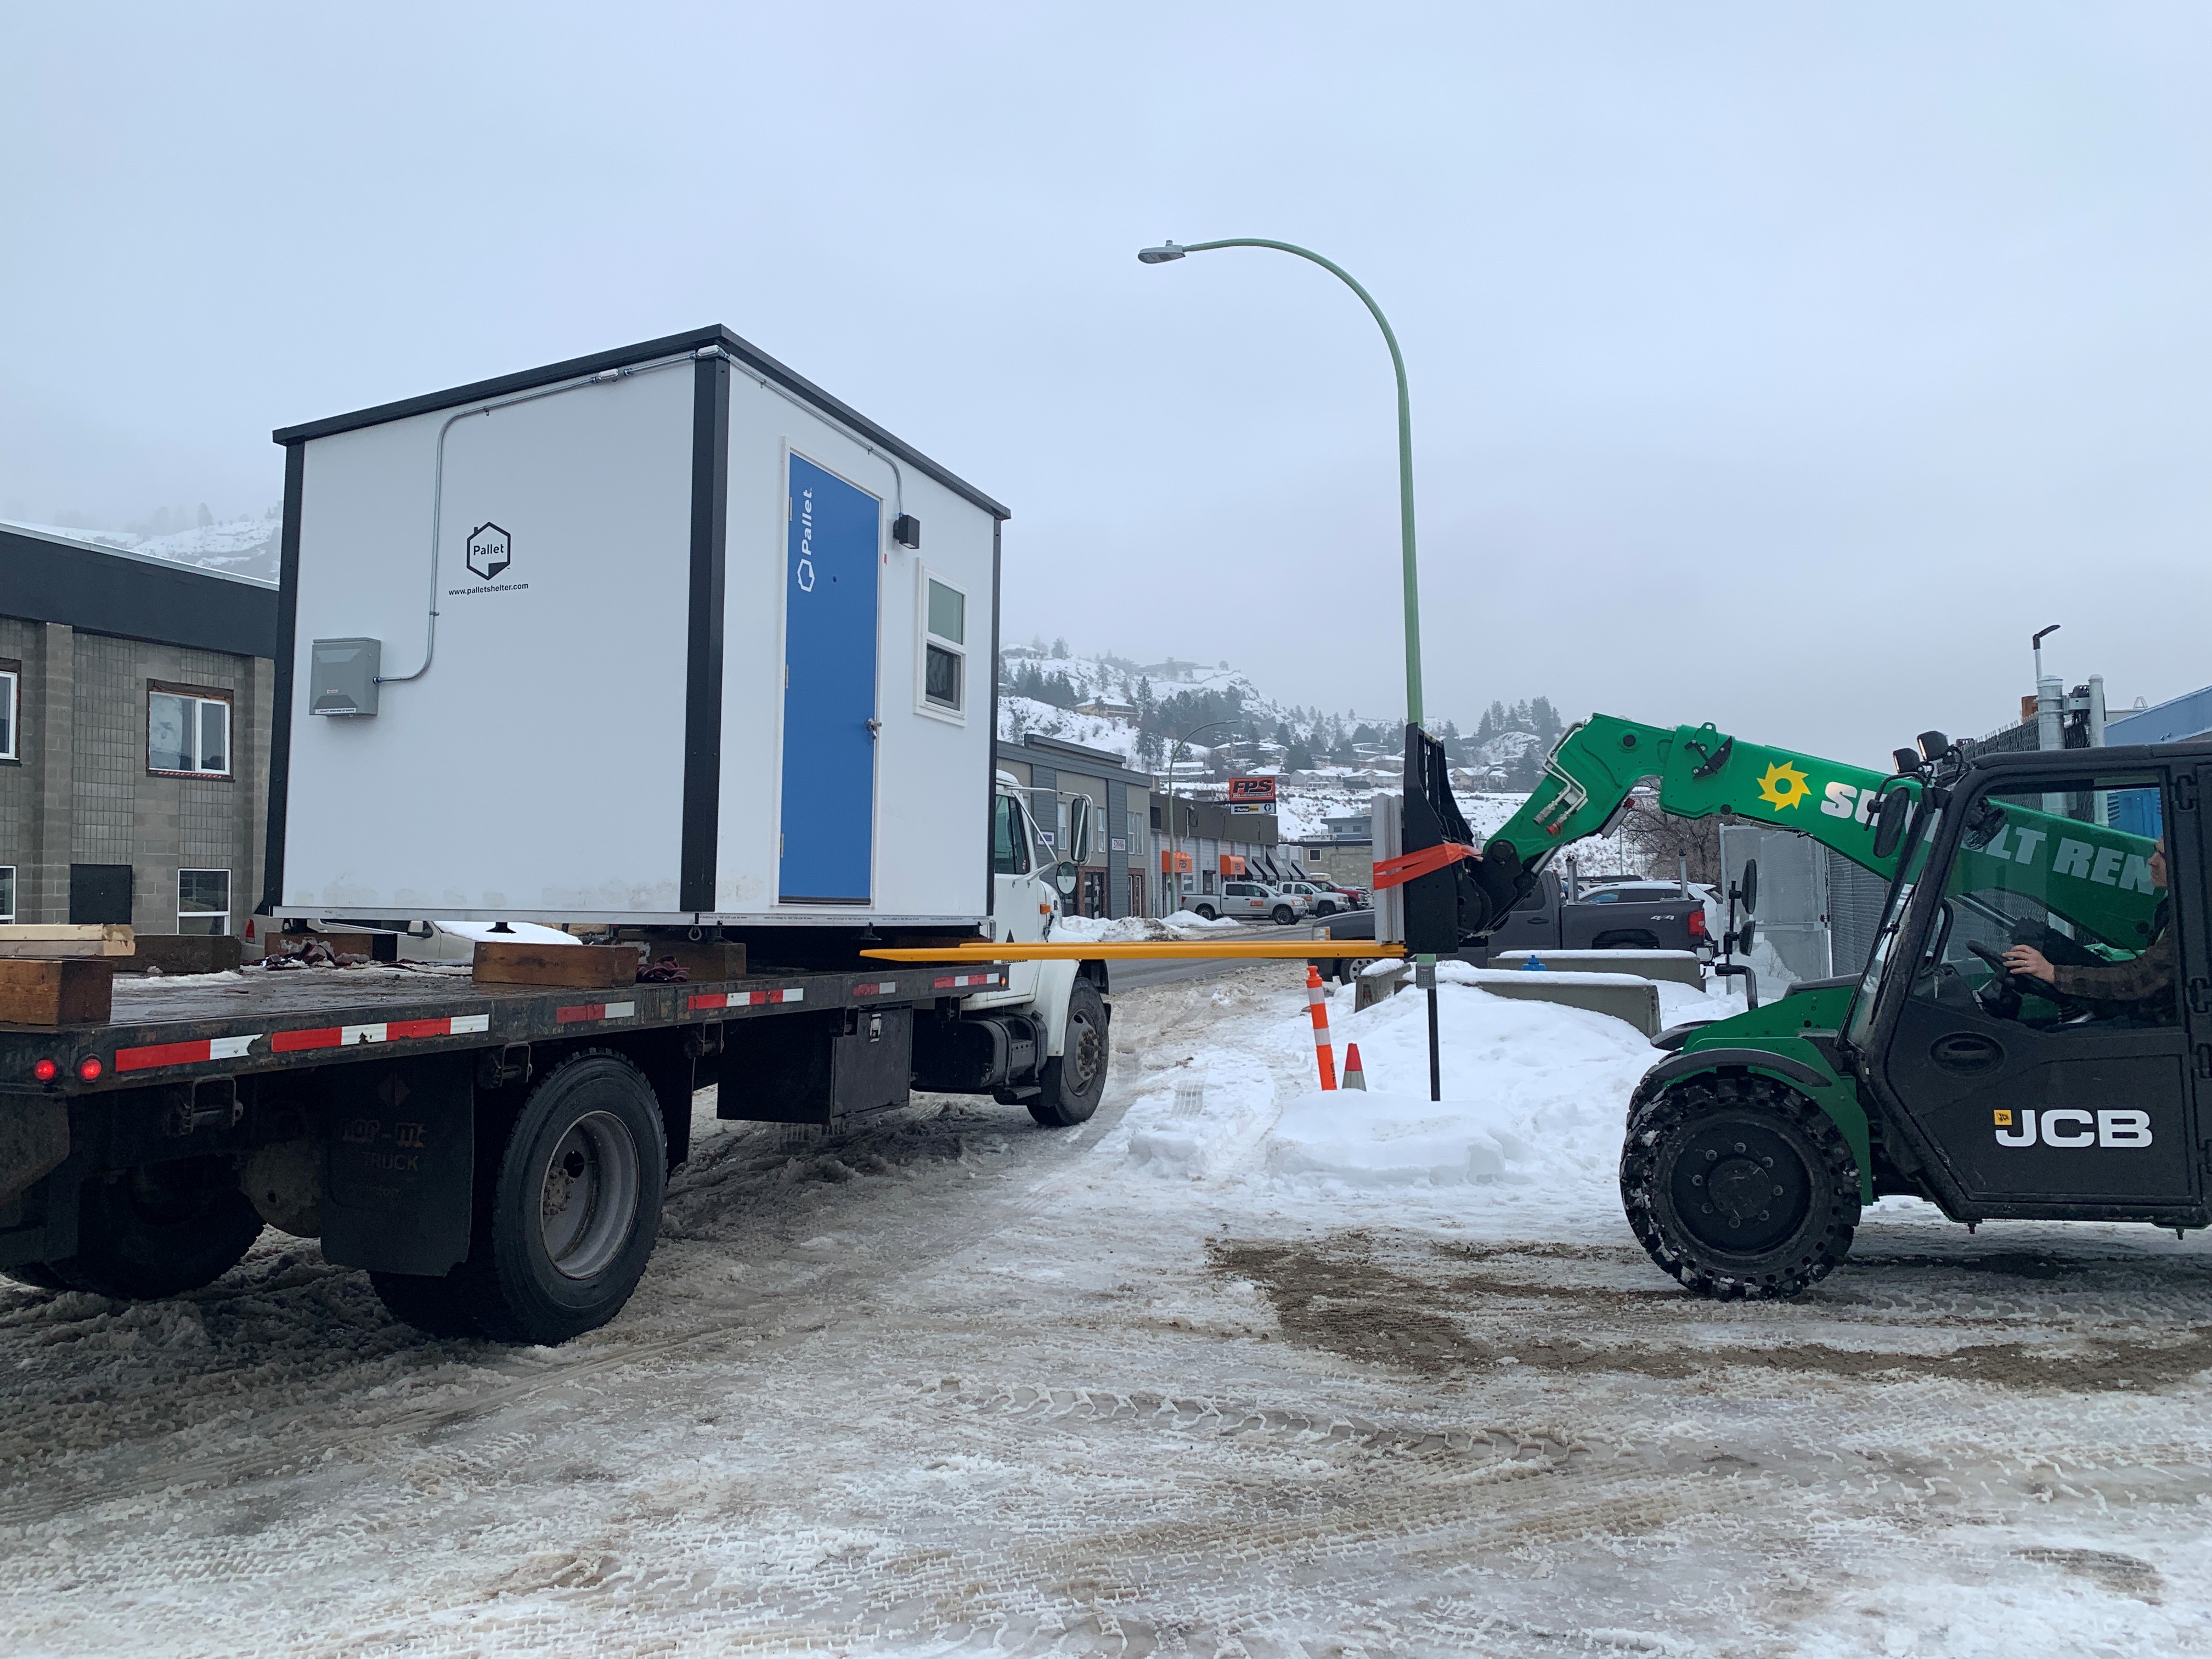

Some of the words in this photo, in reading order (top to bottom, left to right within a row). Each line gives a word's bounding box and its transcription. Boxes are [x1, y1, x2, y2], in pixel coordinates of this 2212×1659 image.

[801, 489, 812, 556] Pallet
[473, 544, 504, 556] Pallet
[448, 582, 528, 596] www.palletshelter.com
[1233, 780, 1273, 793] FPS
[1994, 1109, 2153, 1148] JCB
